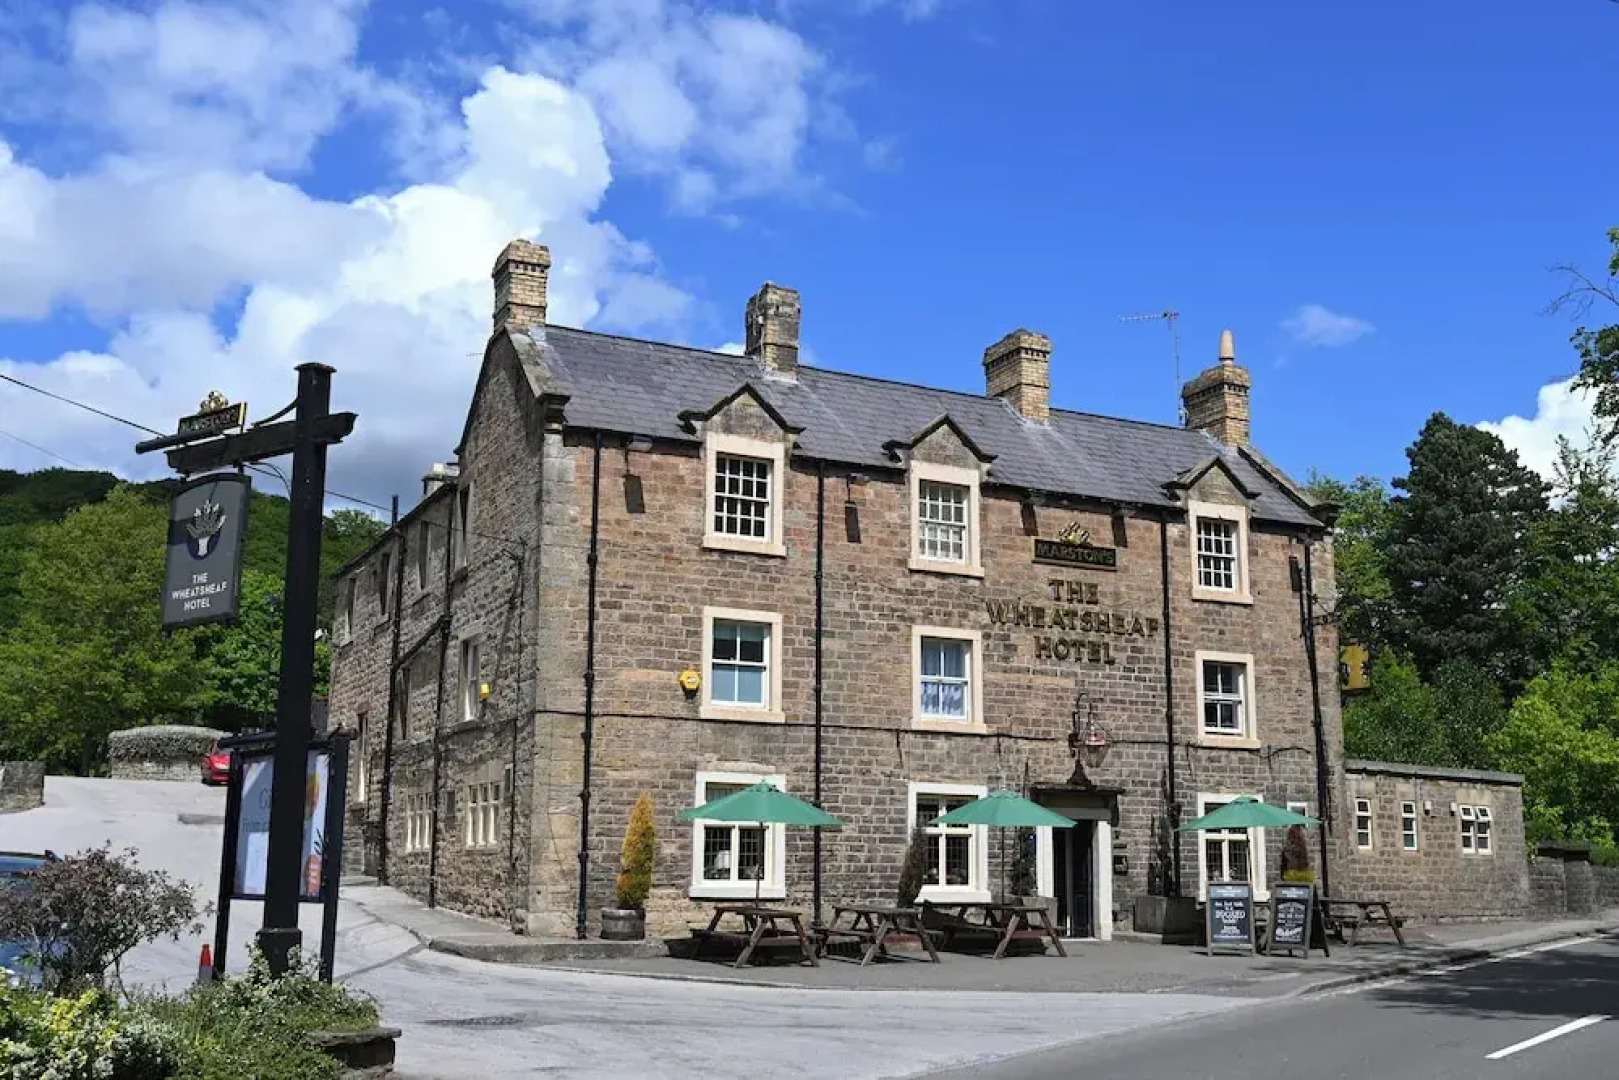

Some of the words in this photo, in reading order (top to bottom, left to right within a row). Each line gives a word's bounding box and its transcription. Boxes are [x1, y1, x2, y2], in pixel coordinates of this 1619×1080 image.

[192, 573, 208, 583] THE
[171, 581, 227, 600] WHEATSHEAF
[1050, 579, 1099, 605] THE
[184, 600, 210, 611] HOTEL
[986, 600, 1158, 637] WHEATSHEAF
[1035, 636, 1115, 665] HOTEL
